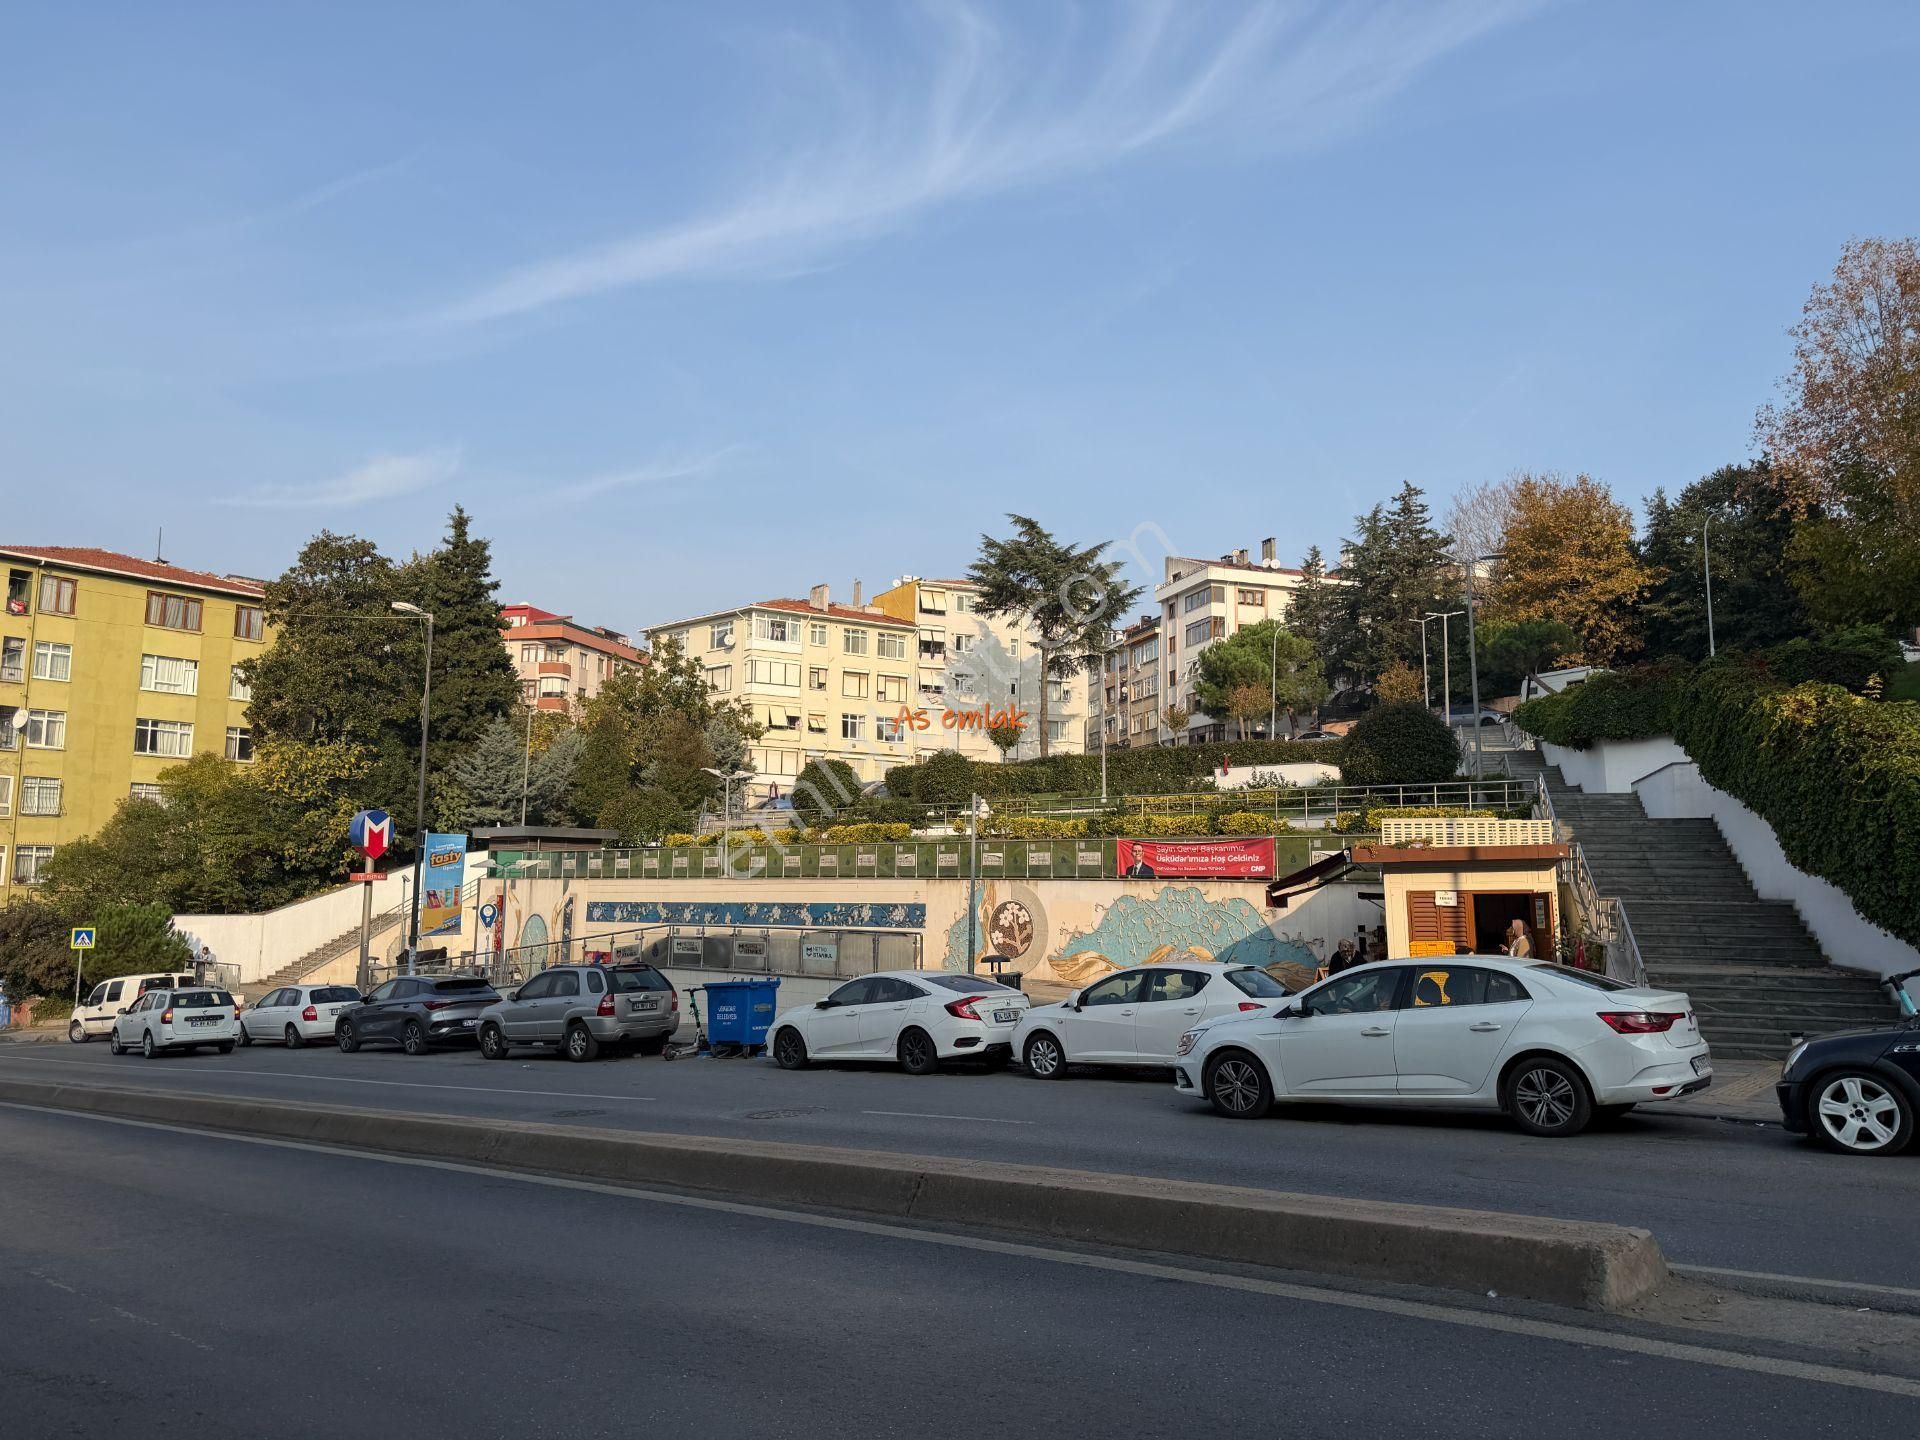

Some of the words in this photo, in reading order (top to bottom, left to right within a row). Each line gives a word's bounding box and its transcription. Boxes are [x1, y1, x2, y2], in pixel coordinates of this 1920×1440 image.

[1177, 845, 1199, 853] Genel
[430, 851, 462, 866] fasty
[1211, 855, 1226, 864] Hoş
[1227, 853, 1260, 862] Geldiniz
